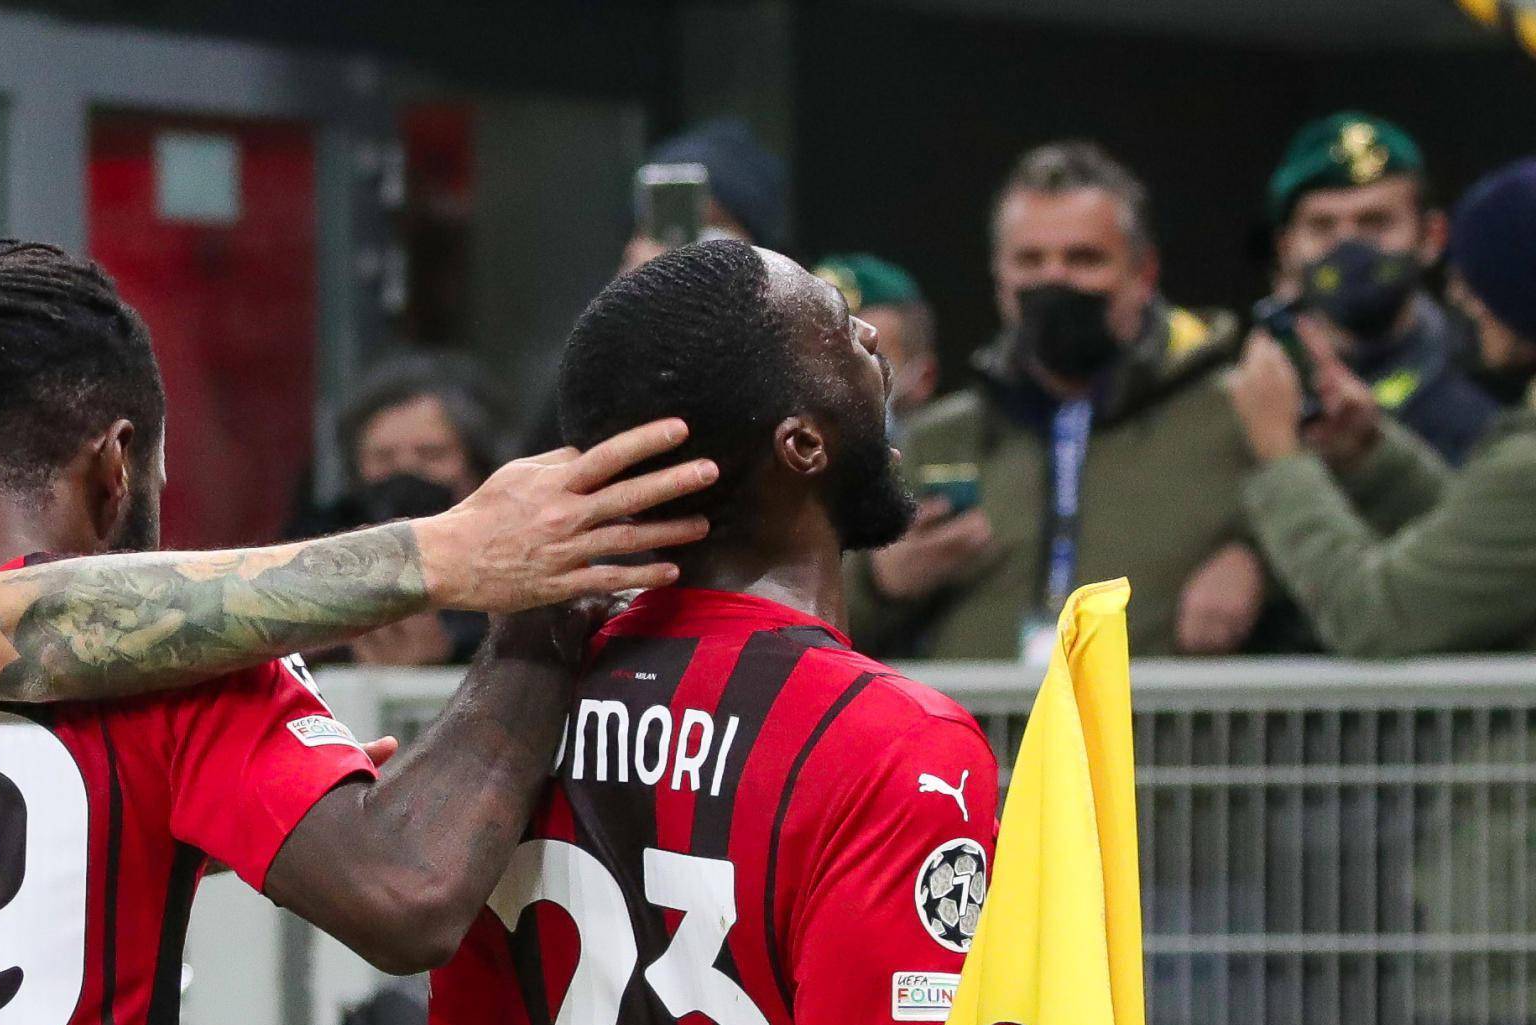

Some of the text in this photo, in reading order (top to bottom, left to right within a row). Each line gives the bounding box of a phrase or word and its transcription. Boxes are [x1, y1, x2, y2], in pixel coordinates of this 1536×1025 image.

[554, 698, 740, 797] MORI
[952, 874, 972, 918] 7
[897, 974, 929, 986] UEFA
